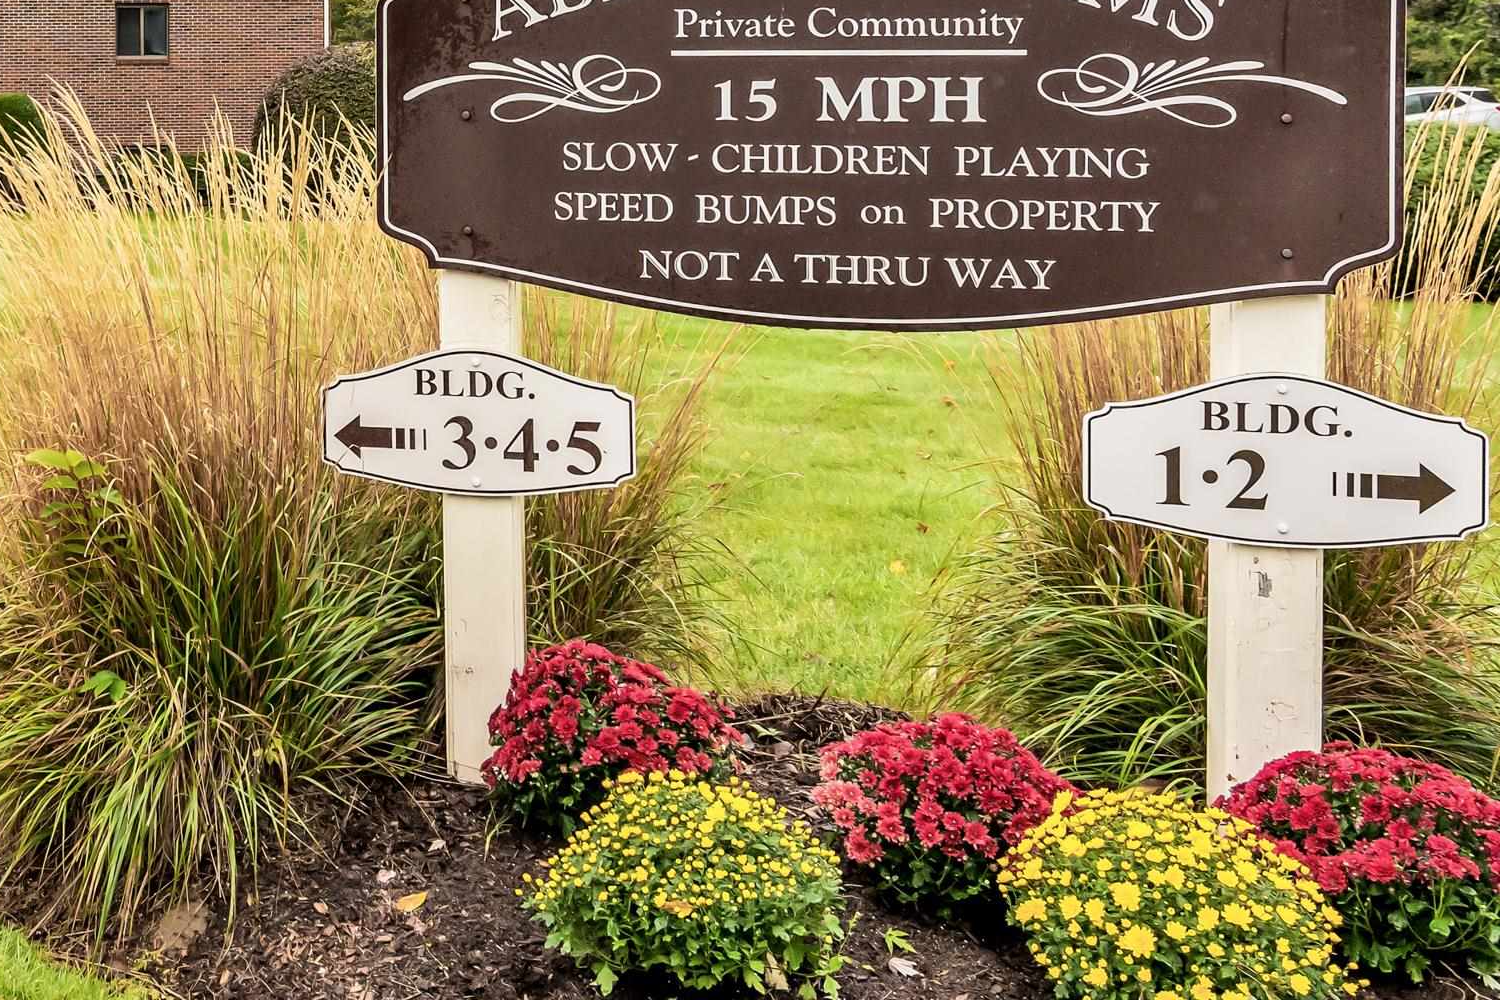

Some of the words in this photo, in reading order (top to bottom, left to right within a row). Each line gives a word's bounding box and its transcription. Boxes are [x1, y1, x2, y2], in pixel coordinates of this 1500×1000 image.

[673, 8, 796, 38] Private
[807, 7, 1024, 45] Community
[713, 78, 777, 122] 15
[814, 76, 987, 123] MPH
[562, 141, 679, 172] SLOW
[711, 143, 931, 176] CHILDREN
[953, 145, 1151, 179] PLAYING
[554, 191, 674, 223] SPEED
[694, 194, 837, 227] BUMPS
[860, 204, 907, 225] on
[928, 198, 1161, 233] PROPERTY
[638, 249, 740, 281] NOT
[749, 252, 785, 283] A
[793, 253, 931, 287] THRU
[943, 257, 1057, 290] WAY
[414, 367, 537, 401] BLDG.
[1201, 400, 1353, 438] BLDG.
